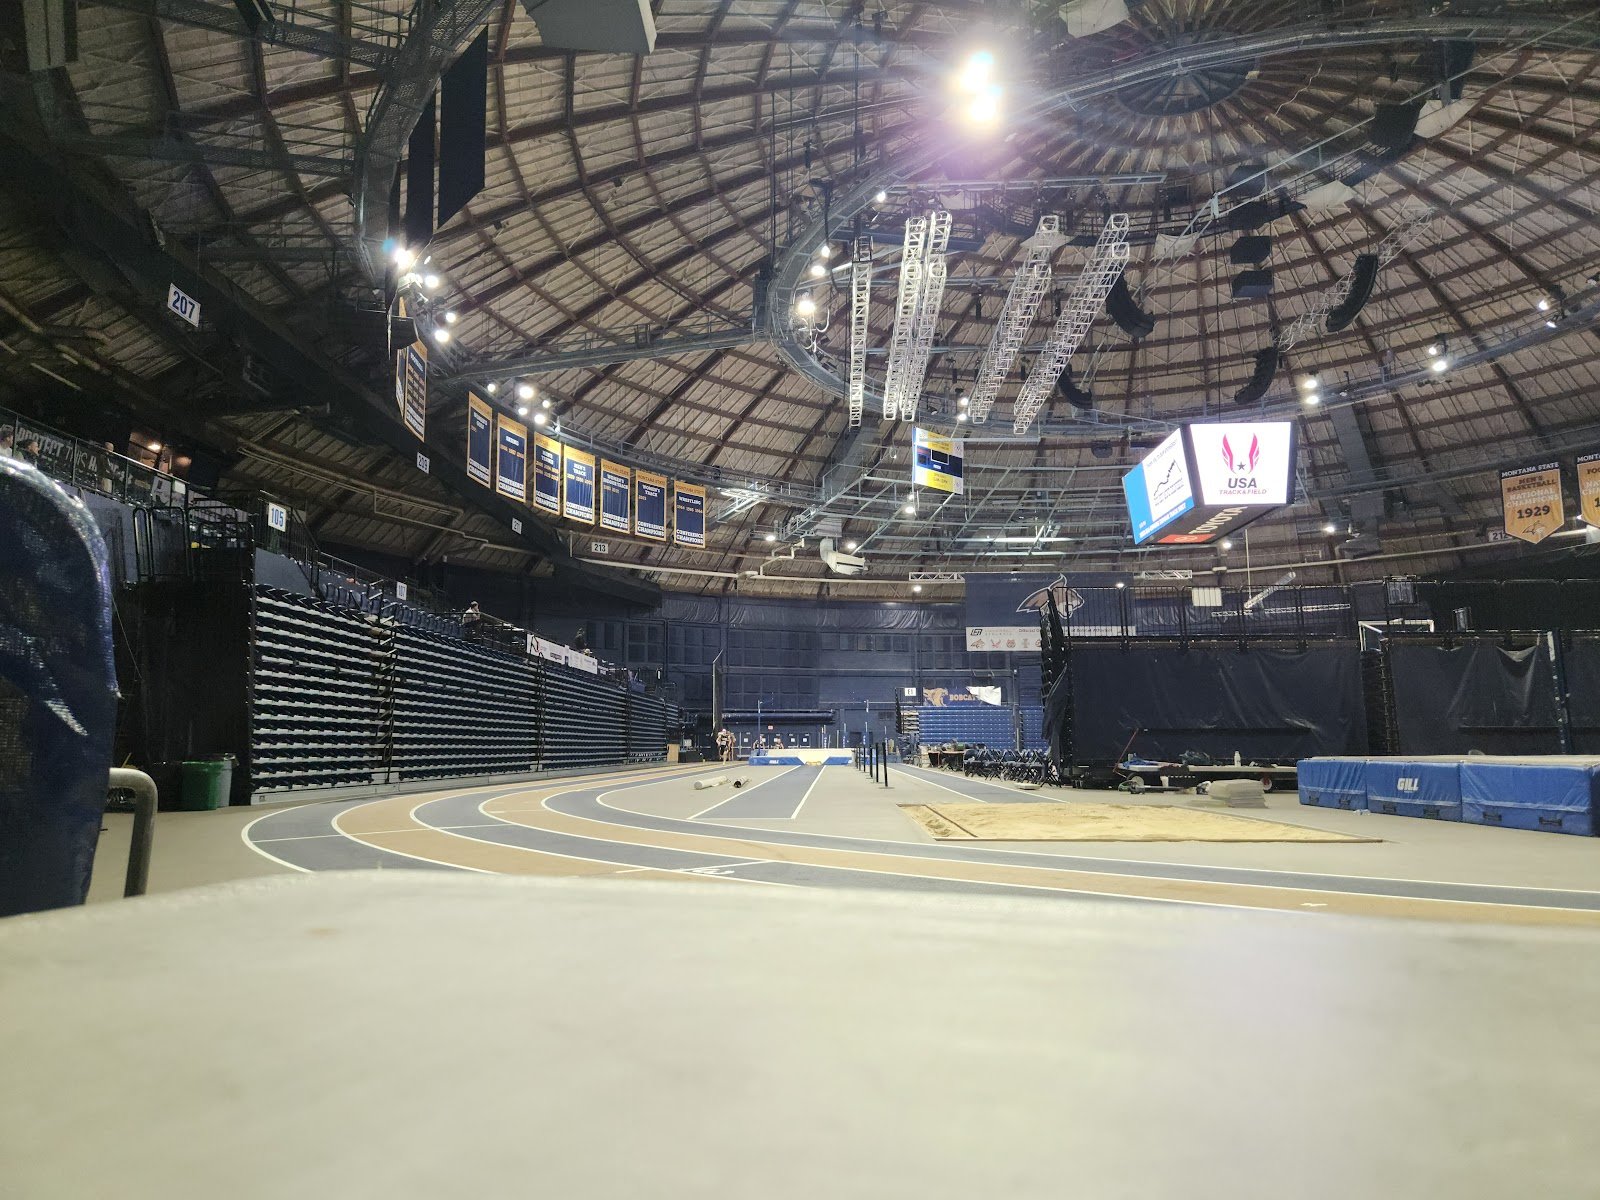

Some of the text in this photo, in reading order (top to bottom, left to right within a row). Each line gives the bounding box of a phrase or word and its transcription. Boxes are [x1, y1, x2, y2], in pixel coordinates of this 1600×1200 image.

[172, 291, 195, 319] 207
[1577, 453, 1600, 463] MONT
[1501, 462, 1559, 478] MONTANA STATE
[1228, 478, 1257, 489] USA
[1506, 479, 1557, 492] BASKETBALL
[1518, 475, 1543, 485] MEN'S
[642, 484, 661, 493] WOMEN'S
[645, 489, 657, 497] TRACK
[1509, 488, 1556, 501] NATIONAL
[678, 496, 701, 505] WRESTLING
[1506, 494, 1560, 507] CHAMPIONS
[271, 508, 284, 527] 105
[566, 507, 592, 520] CHAMPIONS
[1517, 505, 1550, 519] 1929
[603, 518, 628, 529] CHAMPIONS
[638, 521, 664, 531] CONFERENCE
[1188, 506, 1248, 535] TOYOTA
[638, 526, 664, 537] CHAMPIONS
[677, 529, 703, 539] CONFERENCE
[677, 534, 703, 544] CHAMPIONS
[594, 543, 606, 552] 213
[949, 693, 976, 701] BOBCAT
[1397, 777, 1419, 791] GILL
